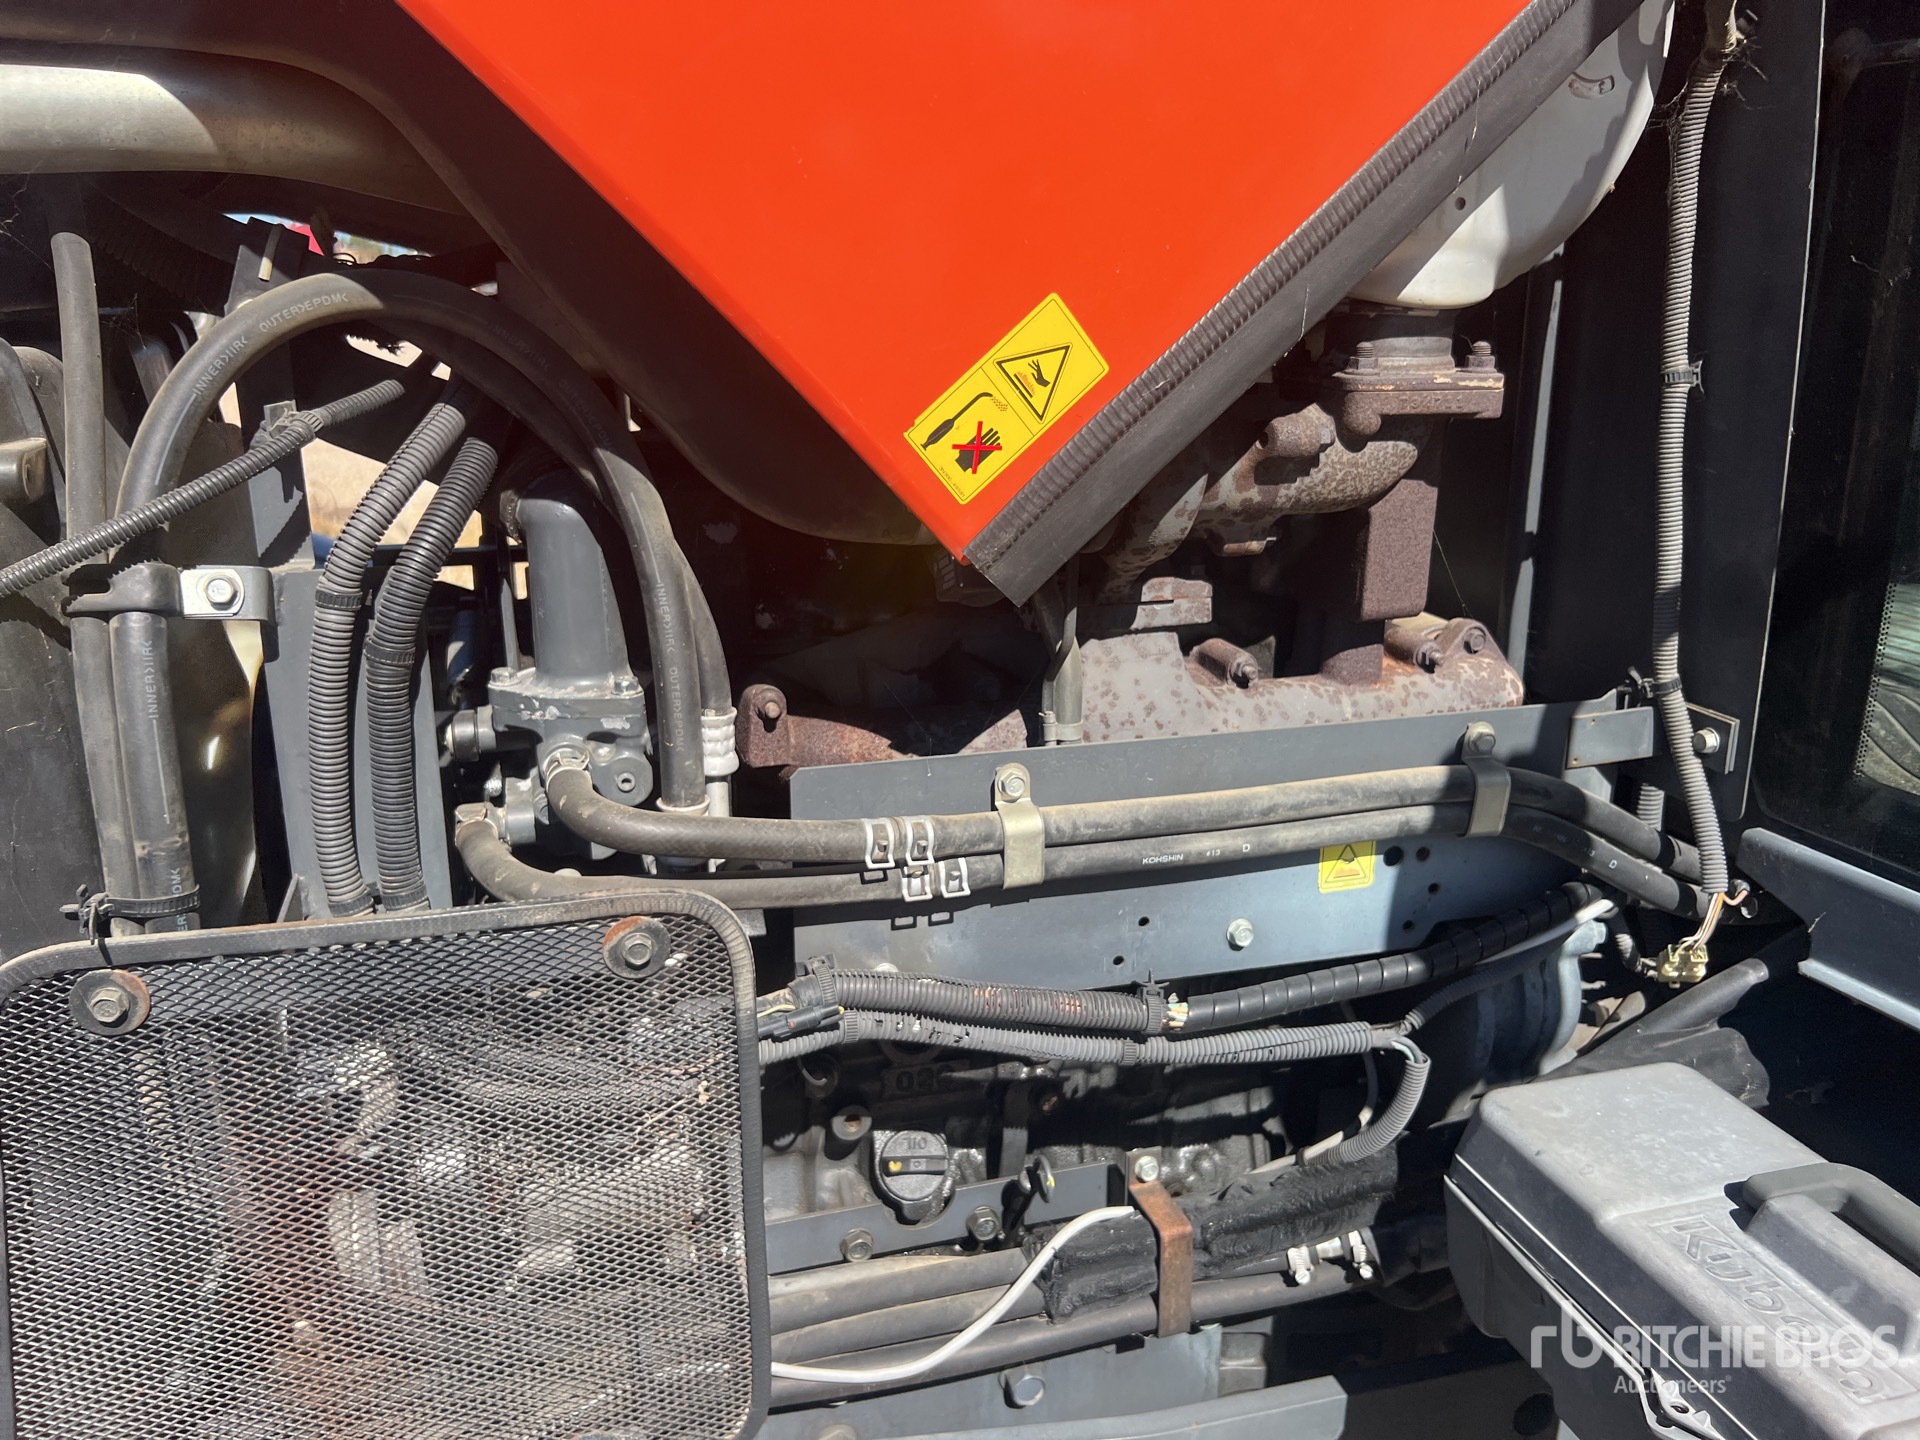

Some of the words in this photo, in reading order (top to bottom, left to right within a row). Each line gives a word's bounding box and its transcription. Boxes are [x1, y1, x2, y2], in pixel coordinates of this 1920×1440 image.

[1142, 853, 1184, 865] KOHSHIN
[1242, 843, 1251, 853] D
[1608, 860, 1618, 869] D
[1672, 1220, 1887, 1402] Kubota
